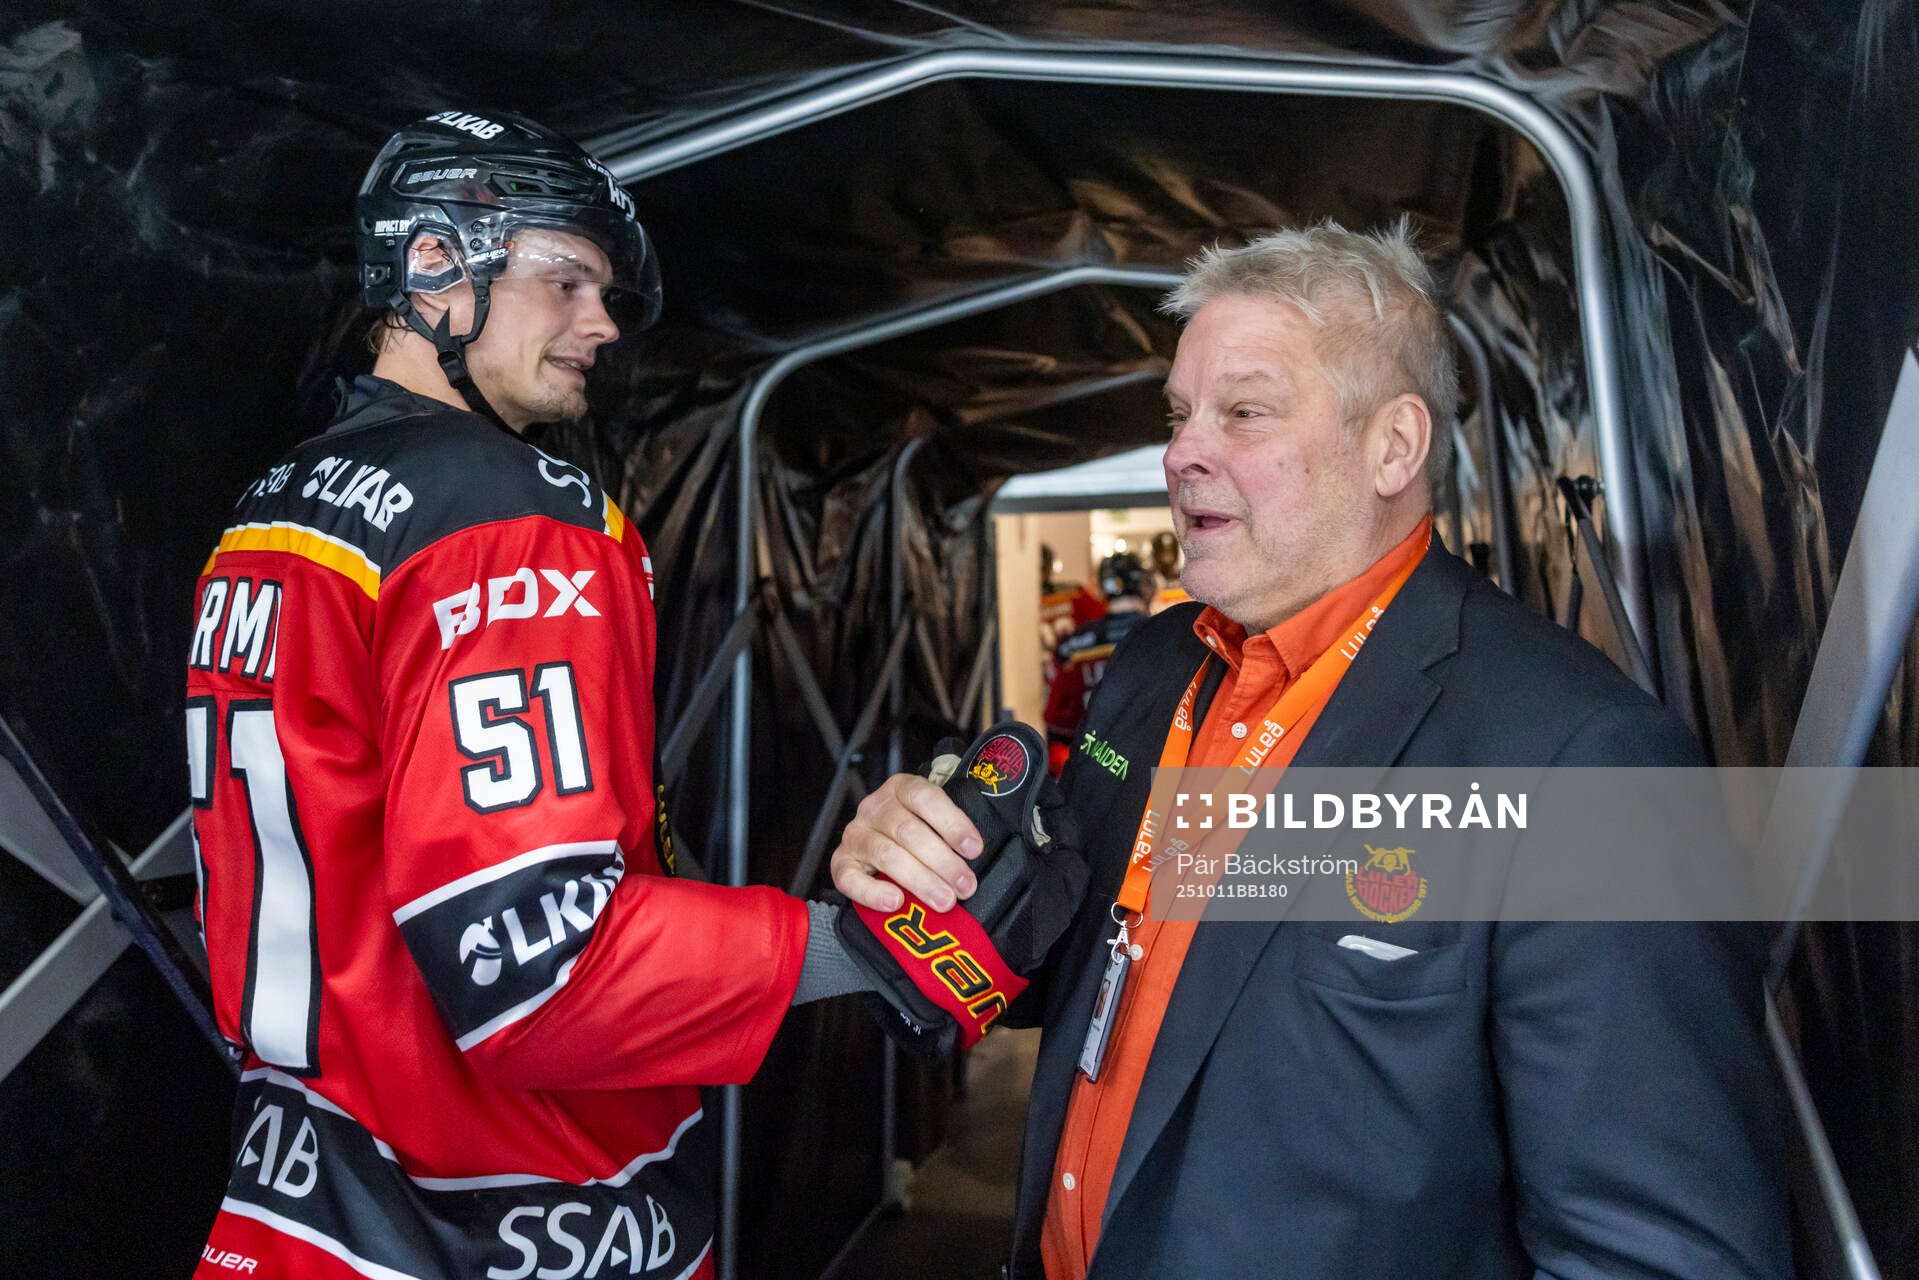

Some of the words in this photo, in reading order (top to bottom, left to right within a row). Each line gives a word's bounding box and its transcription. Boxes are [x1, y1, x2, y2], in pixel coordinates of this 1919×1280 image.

[439, 111, 504, 140] LKAB
[374, 220, 398, 232] IMPACT
[399, 219, 411, 232] BY
[189, 576, 283, 683] RM
[448, 660, 594, 815] 51
[884, 902, 1008, 1035] UER
[235, 1103, 319, 1198] AB
[201, 1244, 258, 1275] UER
[486, 1194, 676, 1280] SSAB
